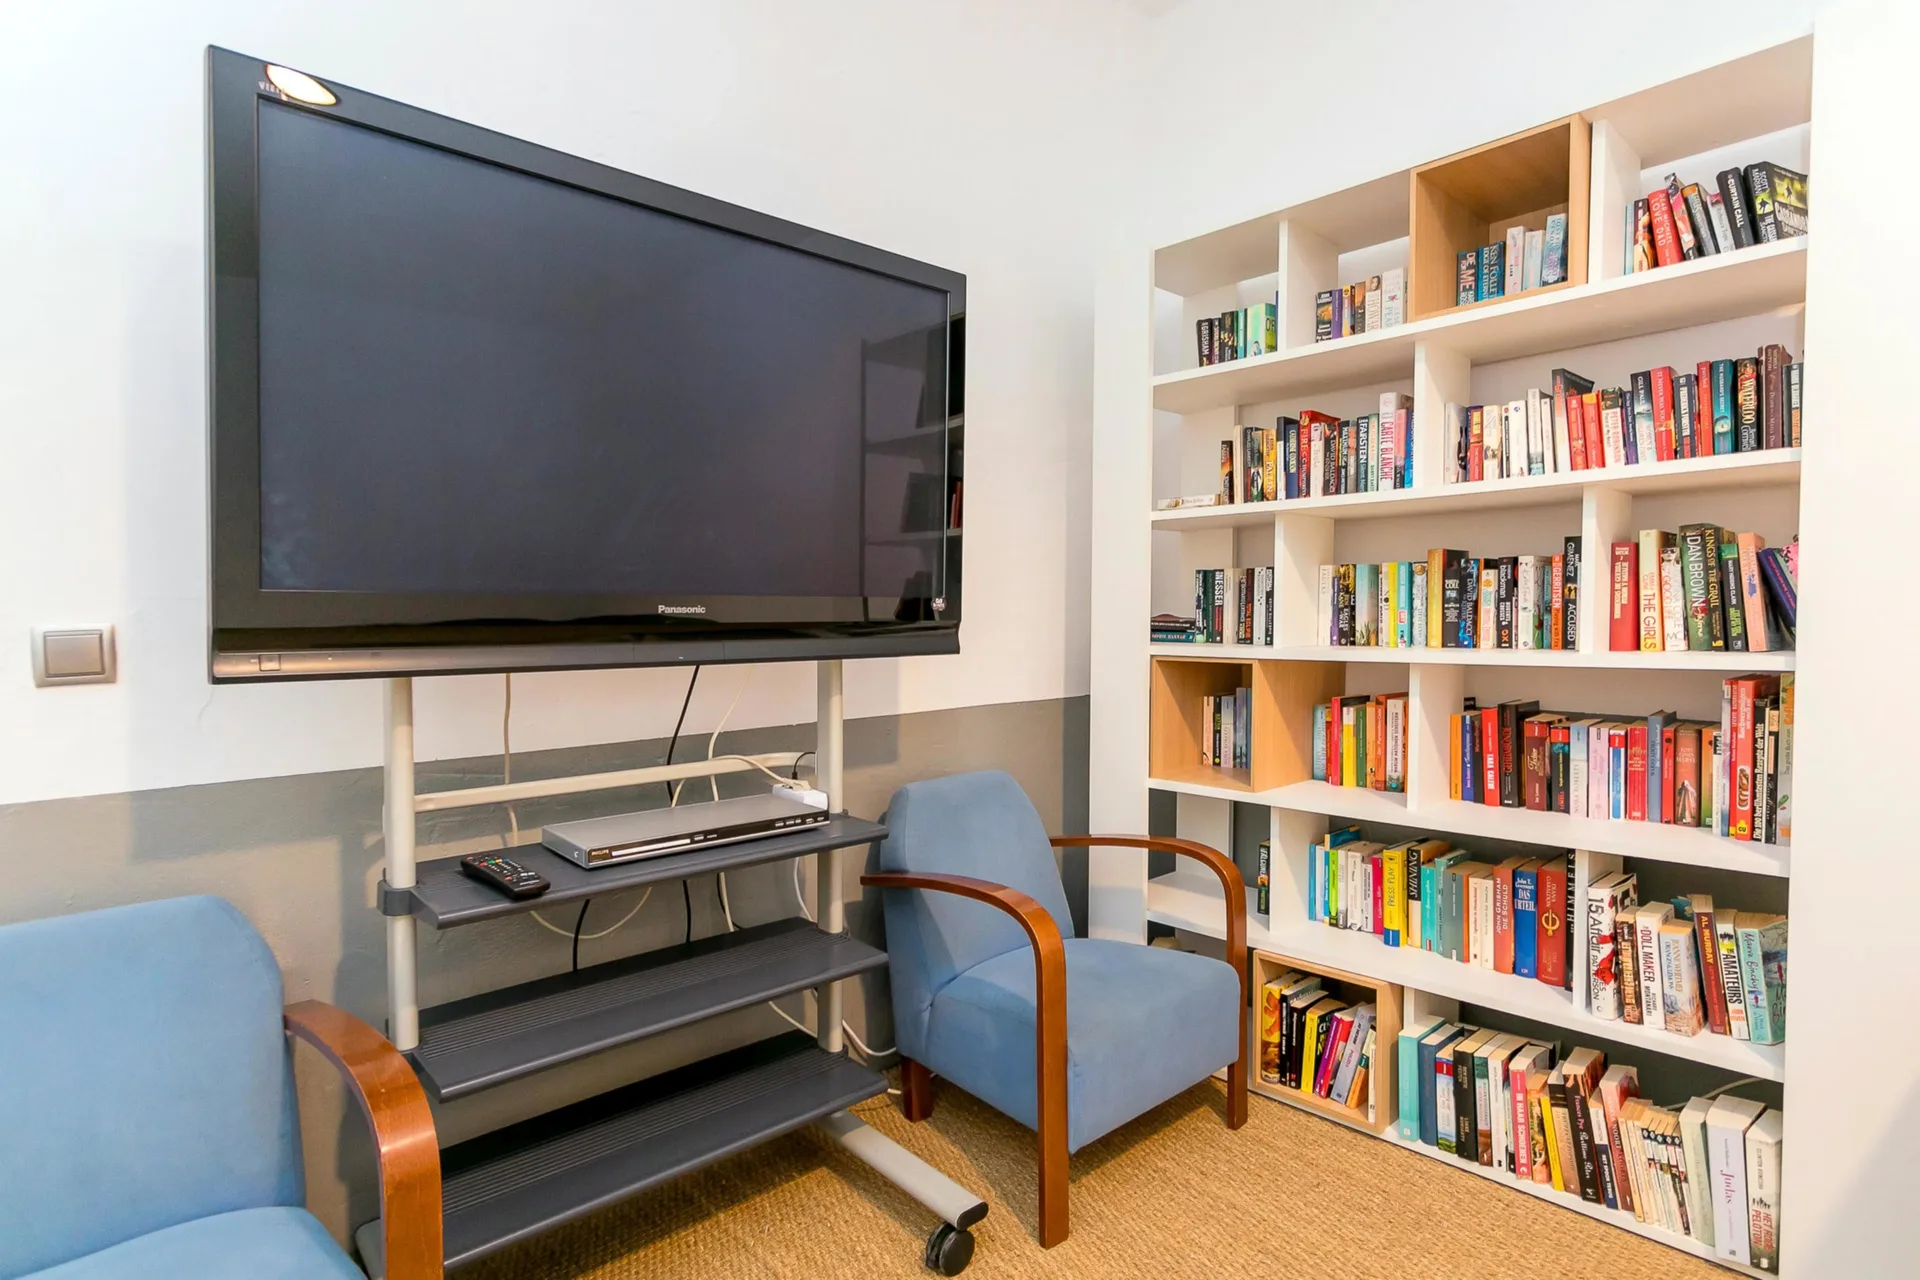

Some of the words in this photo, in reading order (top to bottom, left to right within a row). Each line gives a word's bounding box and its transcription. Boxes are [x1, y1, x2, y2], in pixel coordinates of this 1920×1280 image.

[1752, 168, 1762, 196] MARIANI
[1760, 171, 1768, 189] SCOTT
[1658, 193, 1667, 211] DEAR
[1727, 179, 1740, 208] CURTAIN
[1734, 209, 1744, 227] CALL
[1651, 197, 1661, 224] LOVE
[1656, 228, 1667, 246] DAD
[1662, 214, 1672, 244] MICHAEL
[1466, 252, 1476, 266] DIE
[1490, 245, 1499, 264] KEN
[1460, 268, 1475, 292] ME
[1483, 265, 1489, 273] OF
[1741, 379, 1755, 424] WATERLOO
[1380, 421, 1394, 445] CARTE
[1741, 425, 1750, 452] Cornwell
[1380, 447, 1393, 481] BLANCHE
[1687, 536, 1702, 562] DAN
[1705, 529, 1715, 557] KINGS
[1566, 542, 1574, 577] GIMENEZ
[1499, 564, 1507, 598] blackman
[1553, 568, 1562, 608] GERRITSEN
[1689, 563, 1706, 607] BROWN
[1643, 592, 1656, 613] THE
[1708, 583, 1719, 608] GRAIL
[658, 605, 706, 614] Panasonic
[1466, 602, 1474, 636] BALDACCI
[1567, 603, 1576, 641] ACCUSED
[1643, 616, 1656, 649] GIRLS
[1755, 723, 1764, 738] Welt
[1755, 750, 1764, 773] Rezepte
[1754, 774, 1764, 816] berühmtesten
[1754, 817, 1762, 828] 100
[1409, 851, 1418, 898] SHINING
[1387, 886, 1395, 906] PRESS
[1701, 916, 1708, 927] AL
[1640, 929, 1653, 951] DOLL
[1703, 929, 1714, 964] MURRAY
[1744, 933, 1754, 958] Maeve
[1642, 951, 1656, 982] MAKER
[1722, 953, 1743, 1005] AMATEURS
[1746, 960, 1760, 989] Binchy
[1516, 1093, 1524, 1101] IN
[1574, 1095, 1583, 1117] Frances
[1516, 1103, 1524, 1123] HAAR
[1577, 1118, 1585, 1130] Pye
[1517, 1125, 1527, 1164] SCHOENEN
[1611, 1124, 1621, 1149] NOORT
[1720, 1170, 1735, 1204] Judas
[1752, 1208, 1762, 1246] PELOTON
[1762, 1212, 1773, 1229] HET
